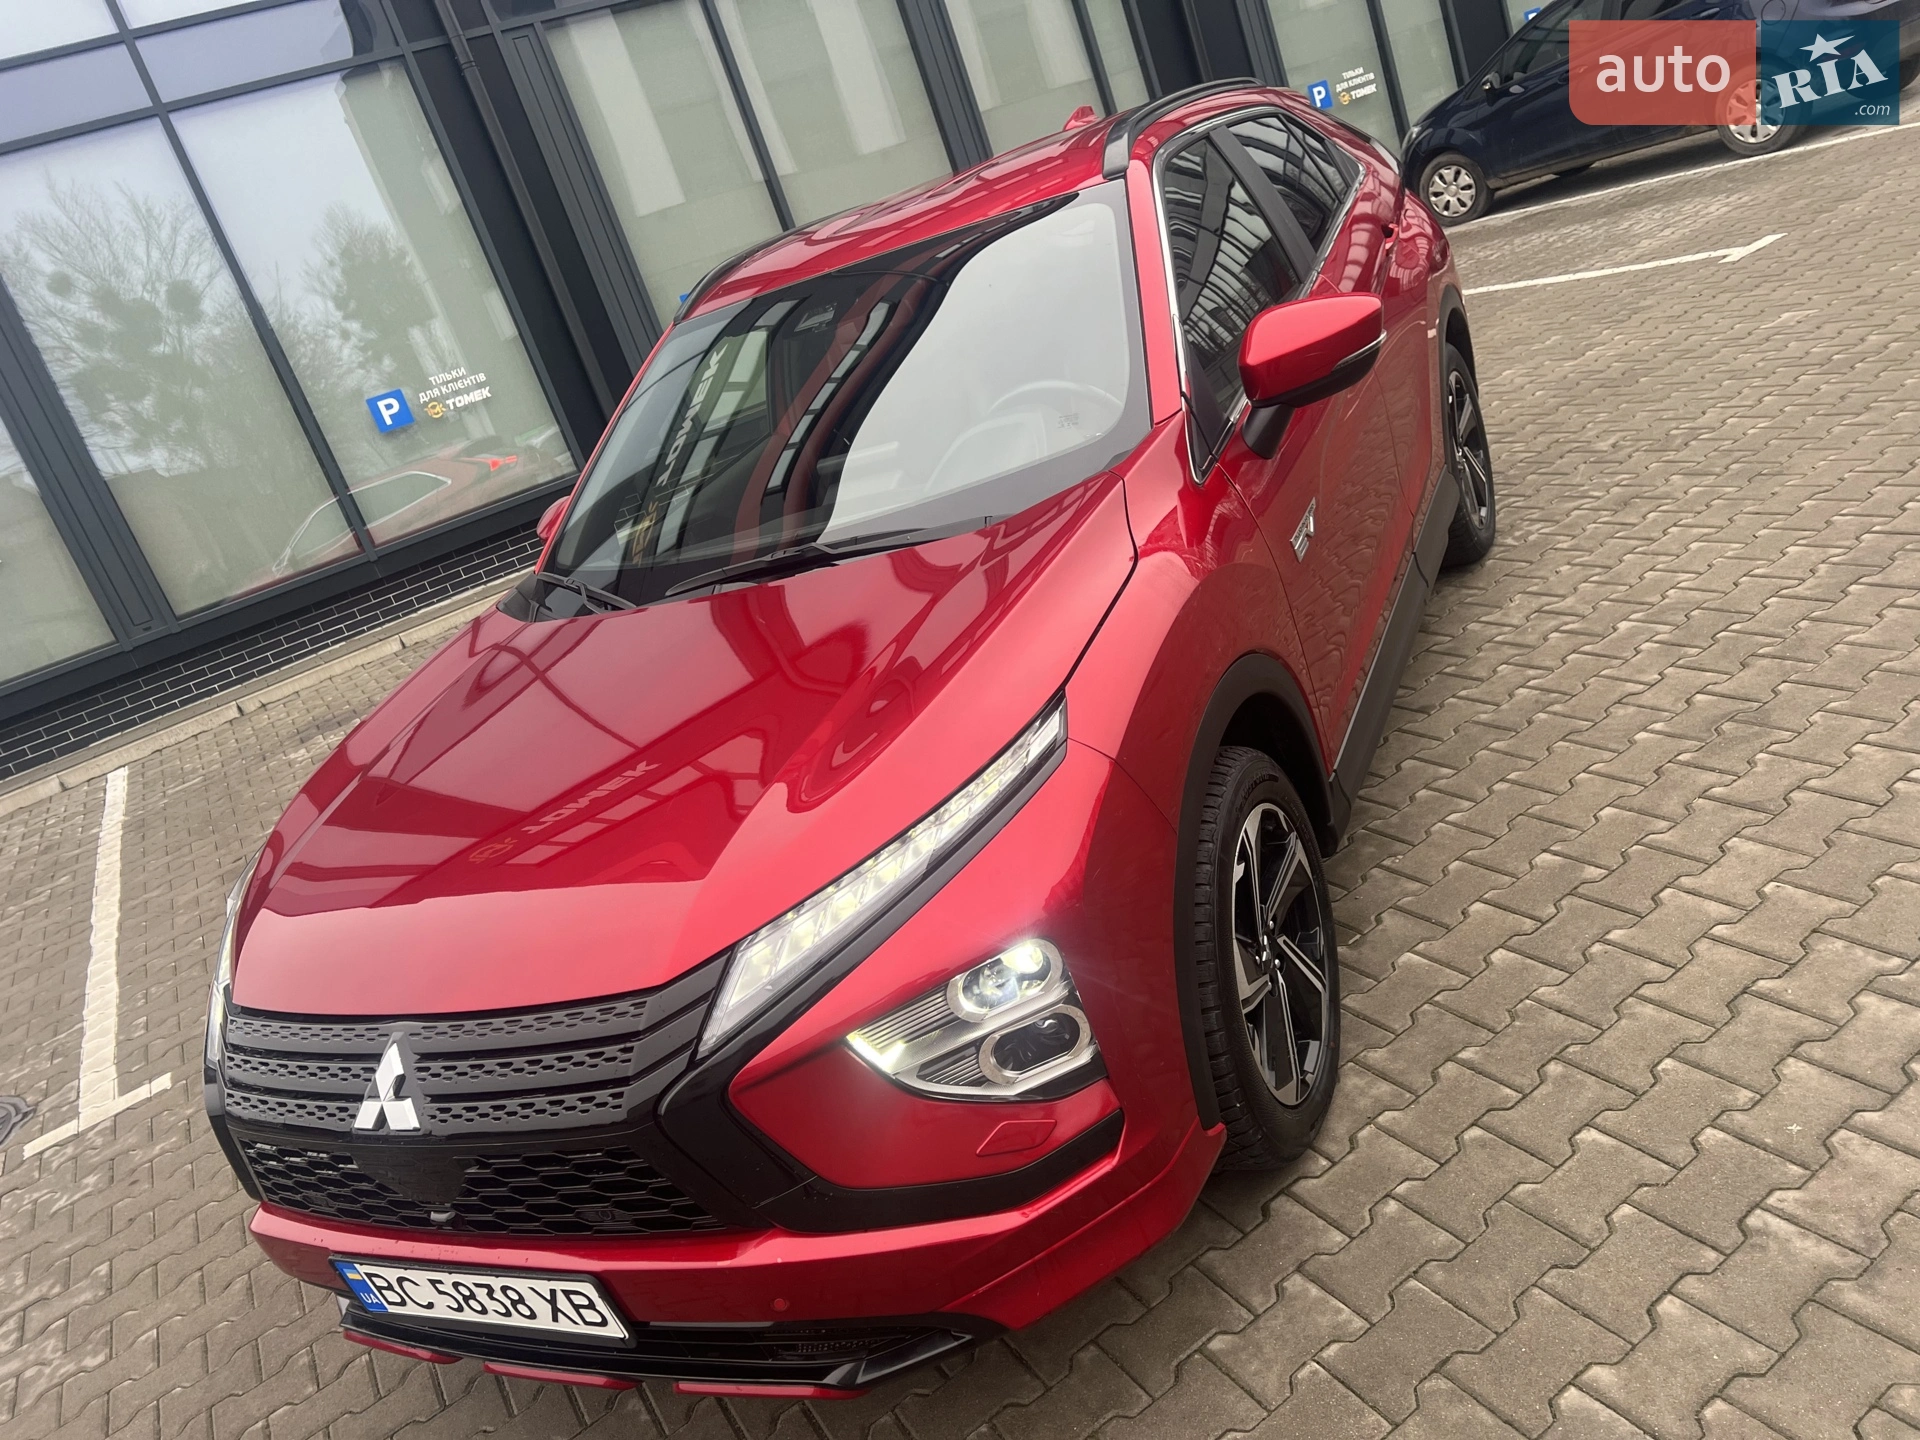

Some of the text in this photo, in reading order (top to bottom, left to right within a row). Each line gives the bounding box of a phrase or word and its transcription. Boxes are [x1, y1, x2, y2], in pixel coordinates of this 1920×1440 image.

[1312, 85, 1326, 108] P
[418, 372, 487, 404] ДЛЯ КЛІЄНТІВ
[428, 366, 467, 386] ТІЛЬКИ
[445, 386, 492, 410] TOMEK
[376, 397, 400, 426] P
[360, 1292, 380, 1305] UA
[363, 1272, 608, 1328] BC 5838 XB
